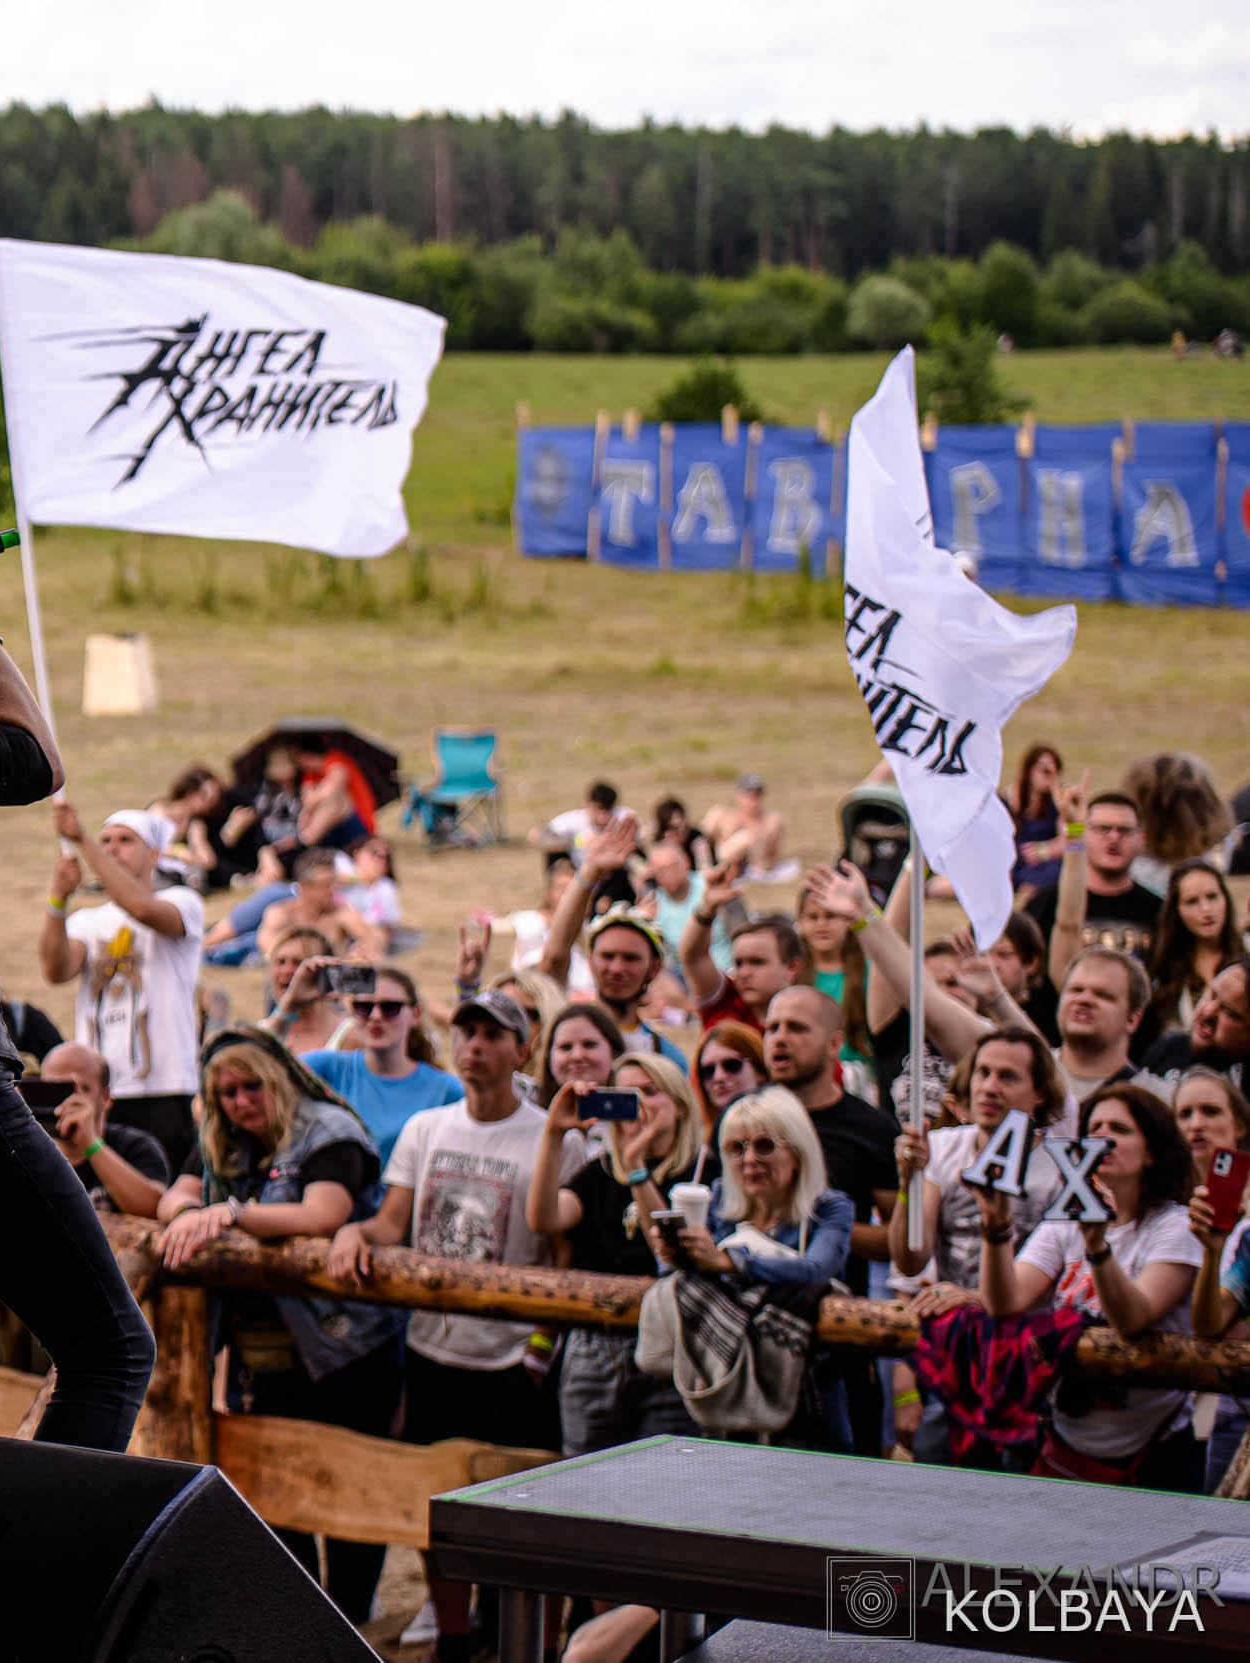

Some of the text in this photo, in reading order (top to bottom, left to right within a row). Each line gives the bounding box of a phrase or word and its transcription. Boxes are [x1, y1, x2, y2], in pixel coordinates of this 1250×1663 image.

[84, 312, 327, 435] АНГЕЛ
[113, 376, 399, 490] ХРАНИТЕЛЬ
[599, 457, 1201, 568] ТАВРНА
